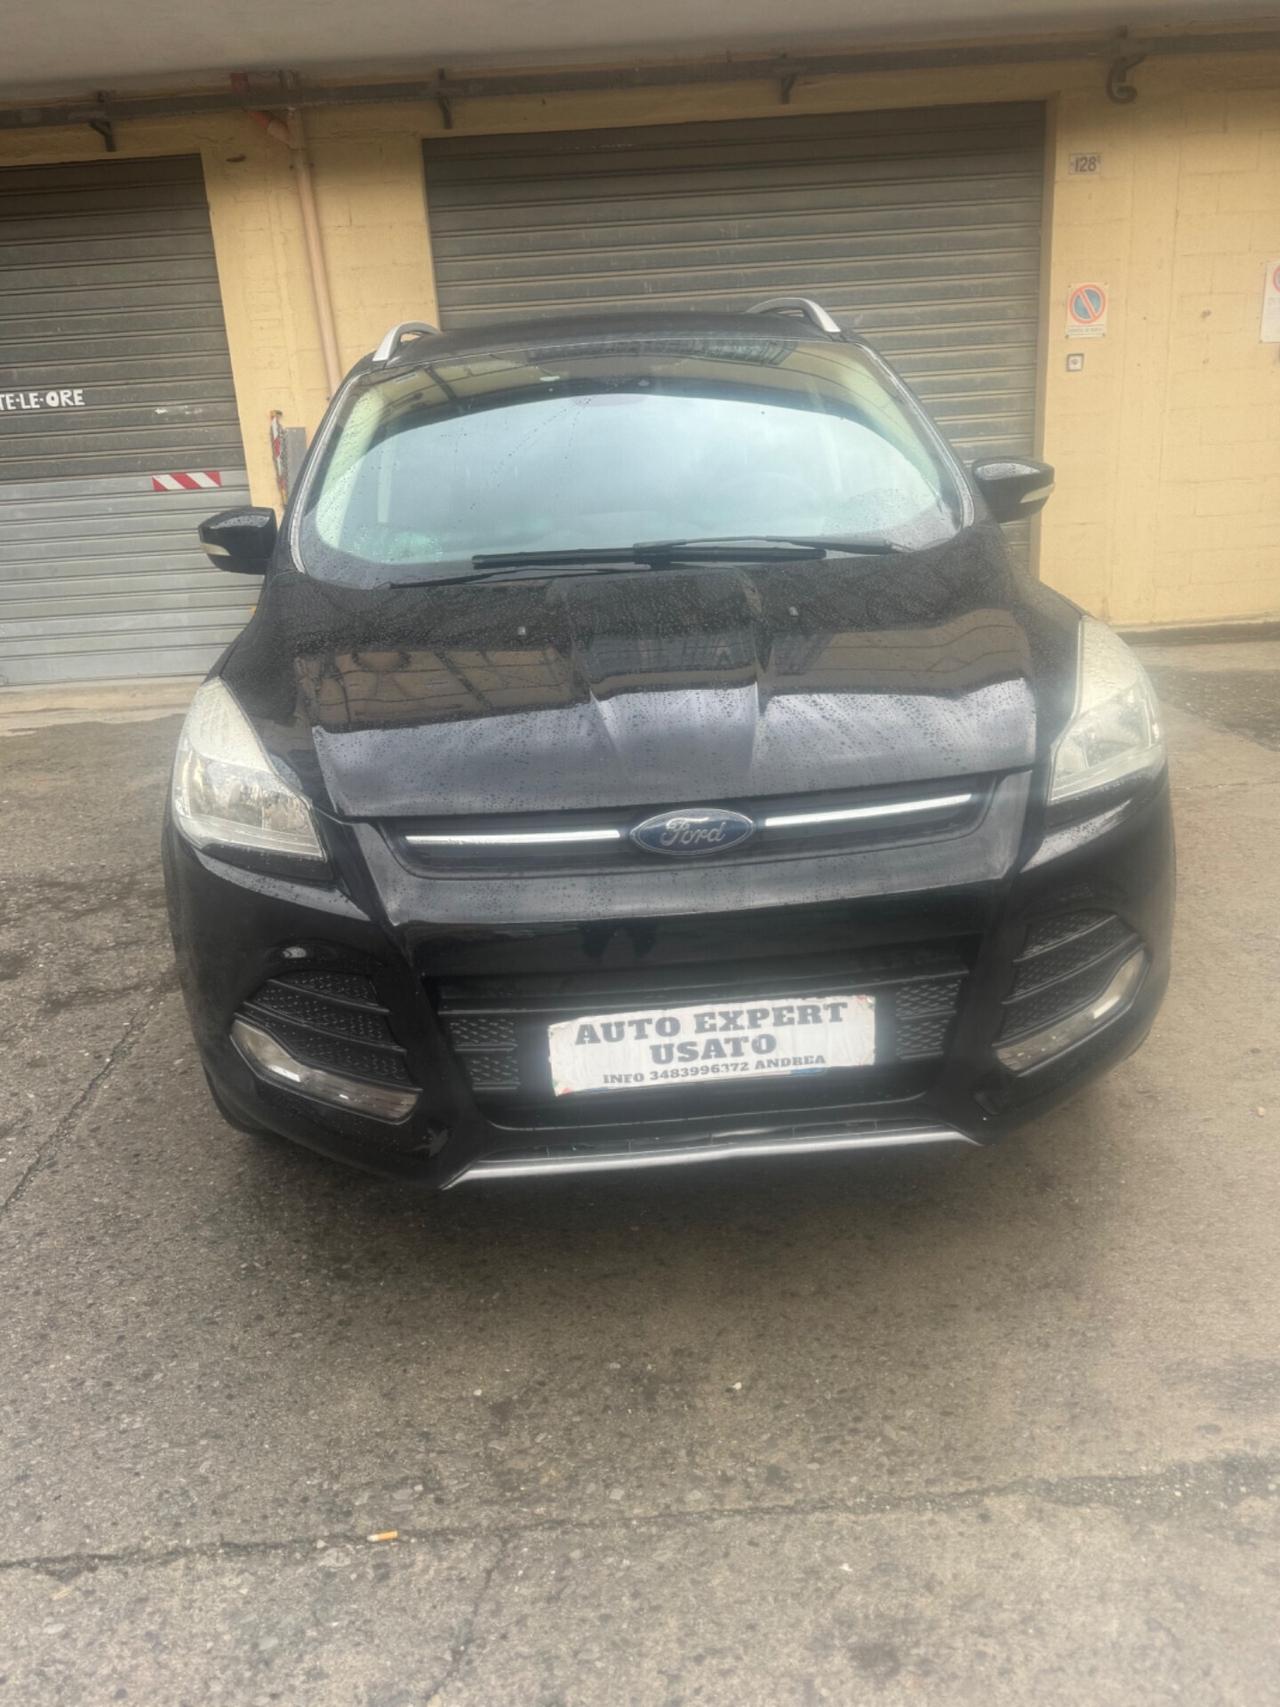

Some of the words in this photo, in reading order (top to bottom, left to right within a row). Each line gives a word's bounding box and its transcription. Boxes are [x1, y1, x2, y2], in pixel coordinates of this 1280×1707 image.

[1074, 155, 1097, 172] 128
[660, 817, 727, 846] Ford
[575, 1016, 681, 1045] AUTO
[694, 1002, 848, 1034] EXPERT
[650, 1033, 777, 1065] USATO
[603, 1072, 645, 1084] INFO
